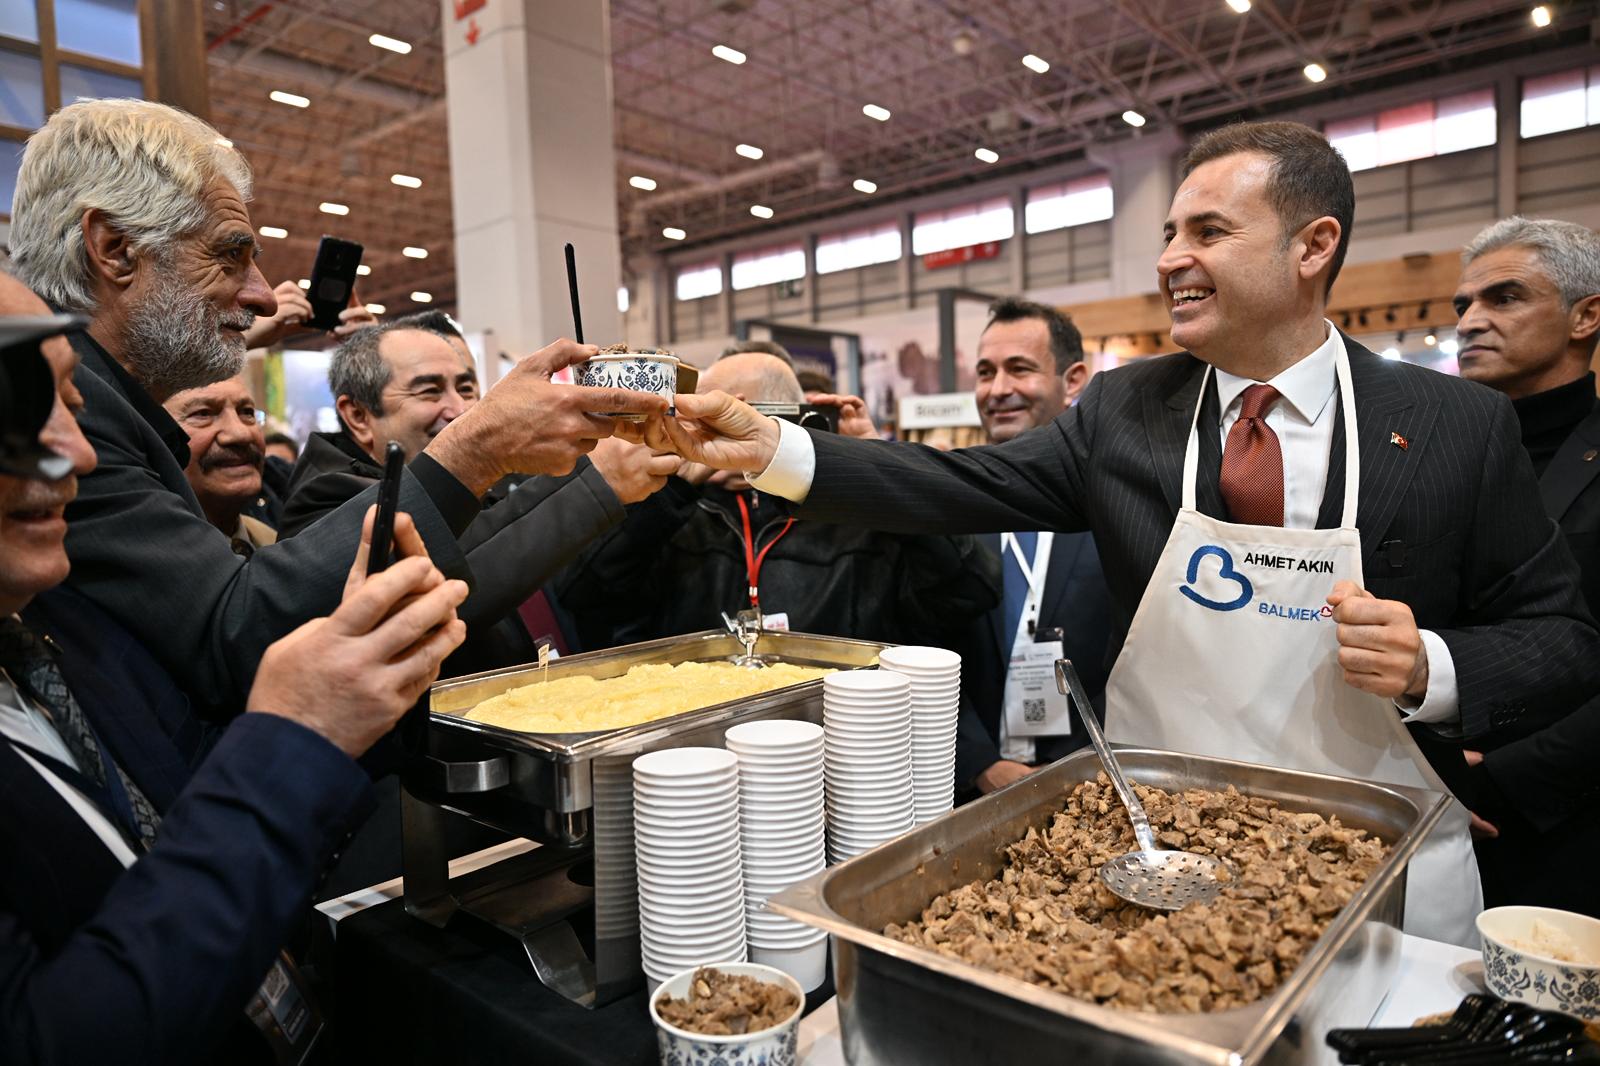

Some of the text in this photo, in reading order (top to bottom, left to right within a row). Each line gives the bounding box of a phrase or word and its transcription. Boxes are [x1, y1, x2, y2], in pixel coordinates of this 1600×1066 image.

[1244, 553, 1333, 573] AHMET AKIN
[1258, 603, 1320, 621] BALMEK
